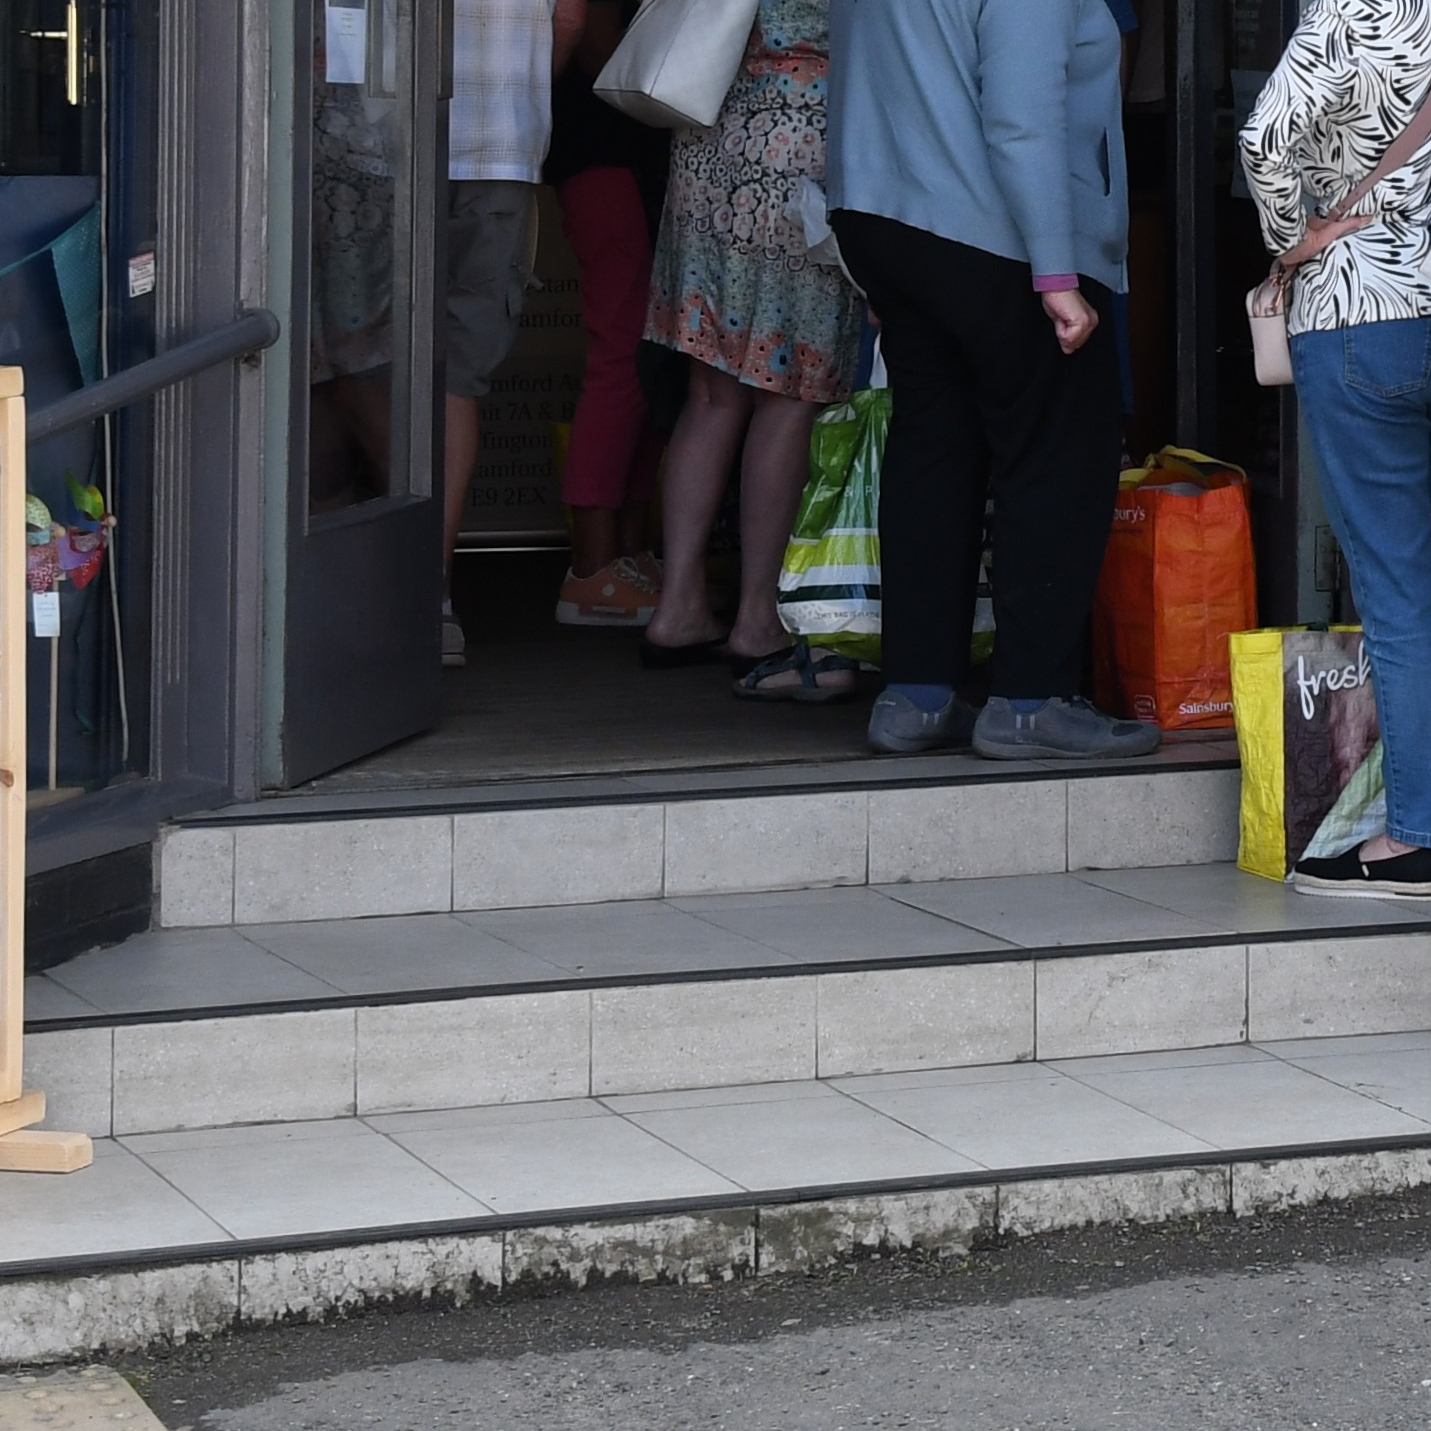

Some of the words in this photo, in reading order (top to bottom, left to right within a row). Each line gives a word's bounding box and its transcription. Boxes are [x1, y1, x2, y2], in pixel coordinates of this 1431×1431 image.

[520, 308, 584, 328] amfor
[491, 373, 553, 393] mford
[507, 402, 532, 421] 7A
[539, 401, 553, 420] &
[472, 458, 552, 478] amford
[472, 487, 498, 506] E9
[504, 487, 547, 506] 2EX
